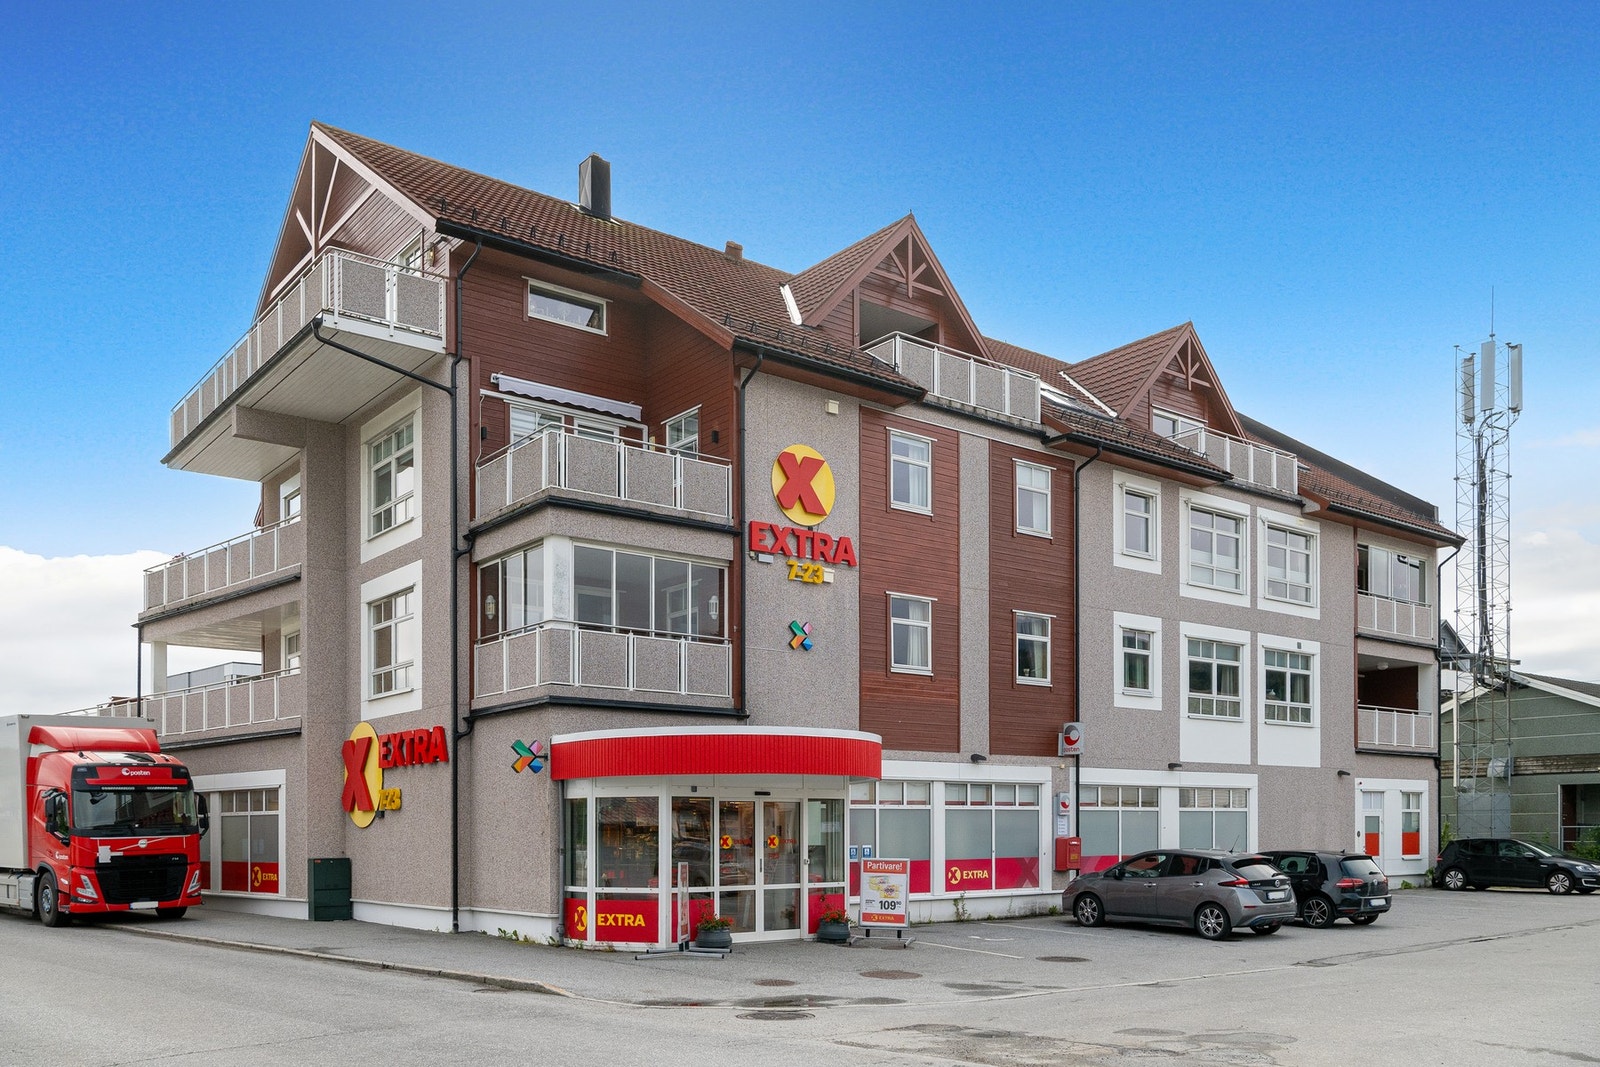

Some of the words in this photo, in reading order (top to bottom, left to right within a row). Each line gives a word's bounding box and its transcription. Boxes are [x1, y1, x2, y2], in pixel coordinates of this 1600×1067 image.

[776, 451, 828, 516] X
[749, 520, 857, 566] EXTRA
[786, 560, 824, 584] 7-23
[378, 725, 449, 768] EXTRA
[341, 736, 375, 812] X
[867, 861, 903, 871] Partivare!
[962, 870, 989, 879] EXTRA
[262, 873, 278, 881] EXTRA
[879, 900, 897, 910] 109
[597, 913, 646, 927] EXTRA
